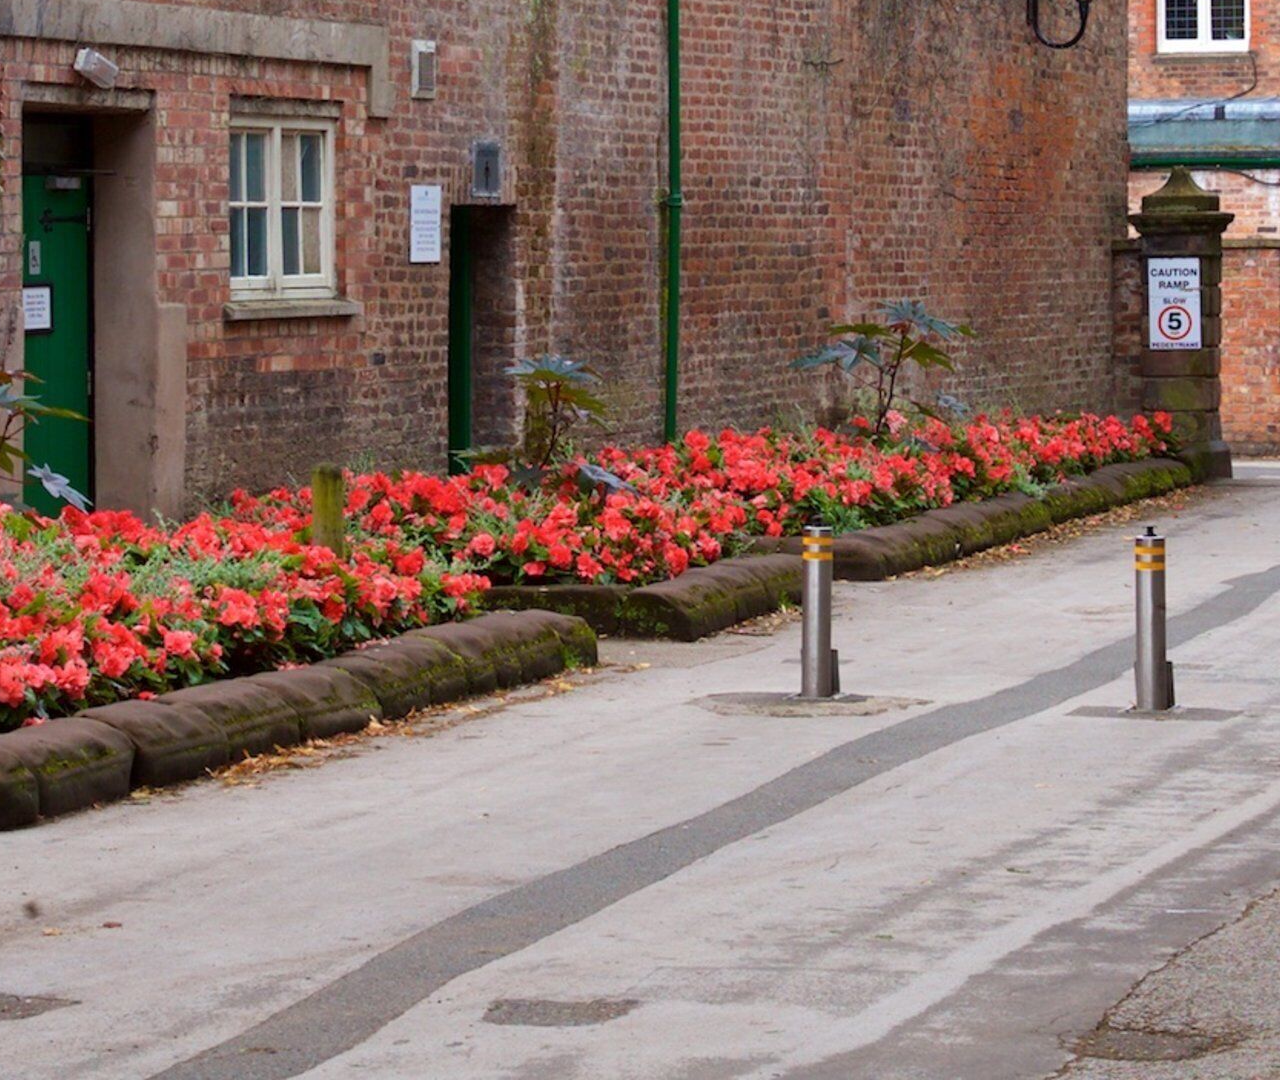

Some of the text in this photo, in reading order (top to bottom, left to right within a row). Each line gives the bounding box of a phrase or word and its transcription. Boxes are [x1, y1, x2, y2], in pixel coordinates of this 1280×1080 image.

[1150, 268, 1197, 277] CAUTION
[1158, 280, 1190, 289] RAMP
[1162, 297, 1186, 305] SLOW
[1167, 312, 1182, 331] 5
